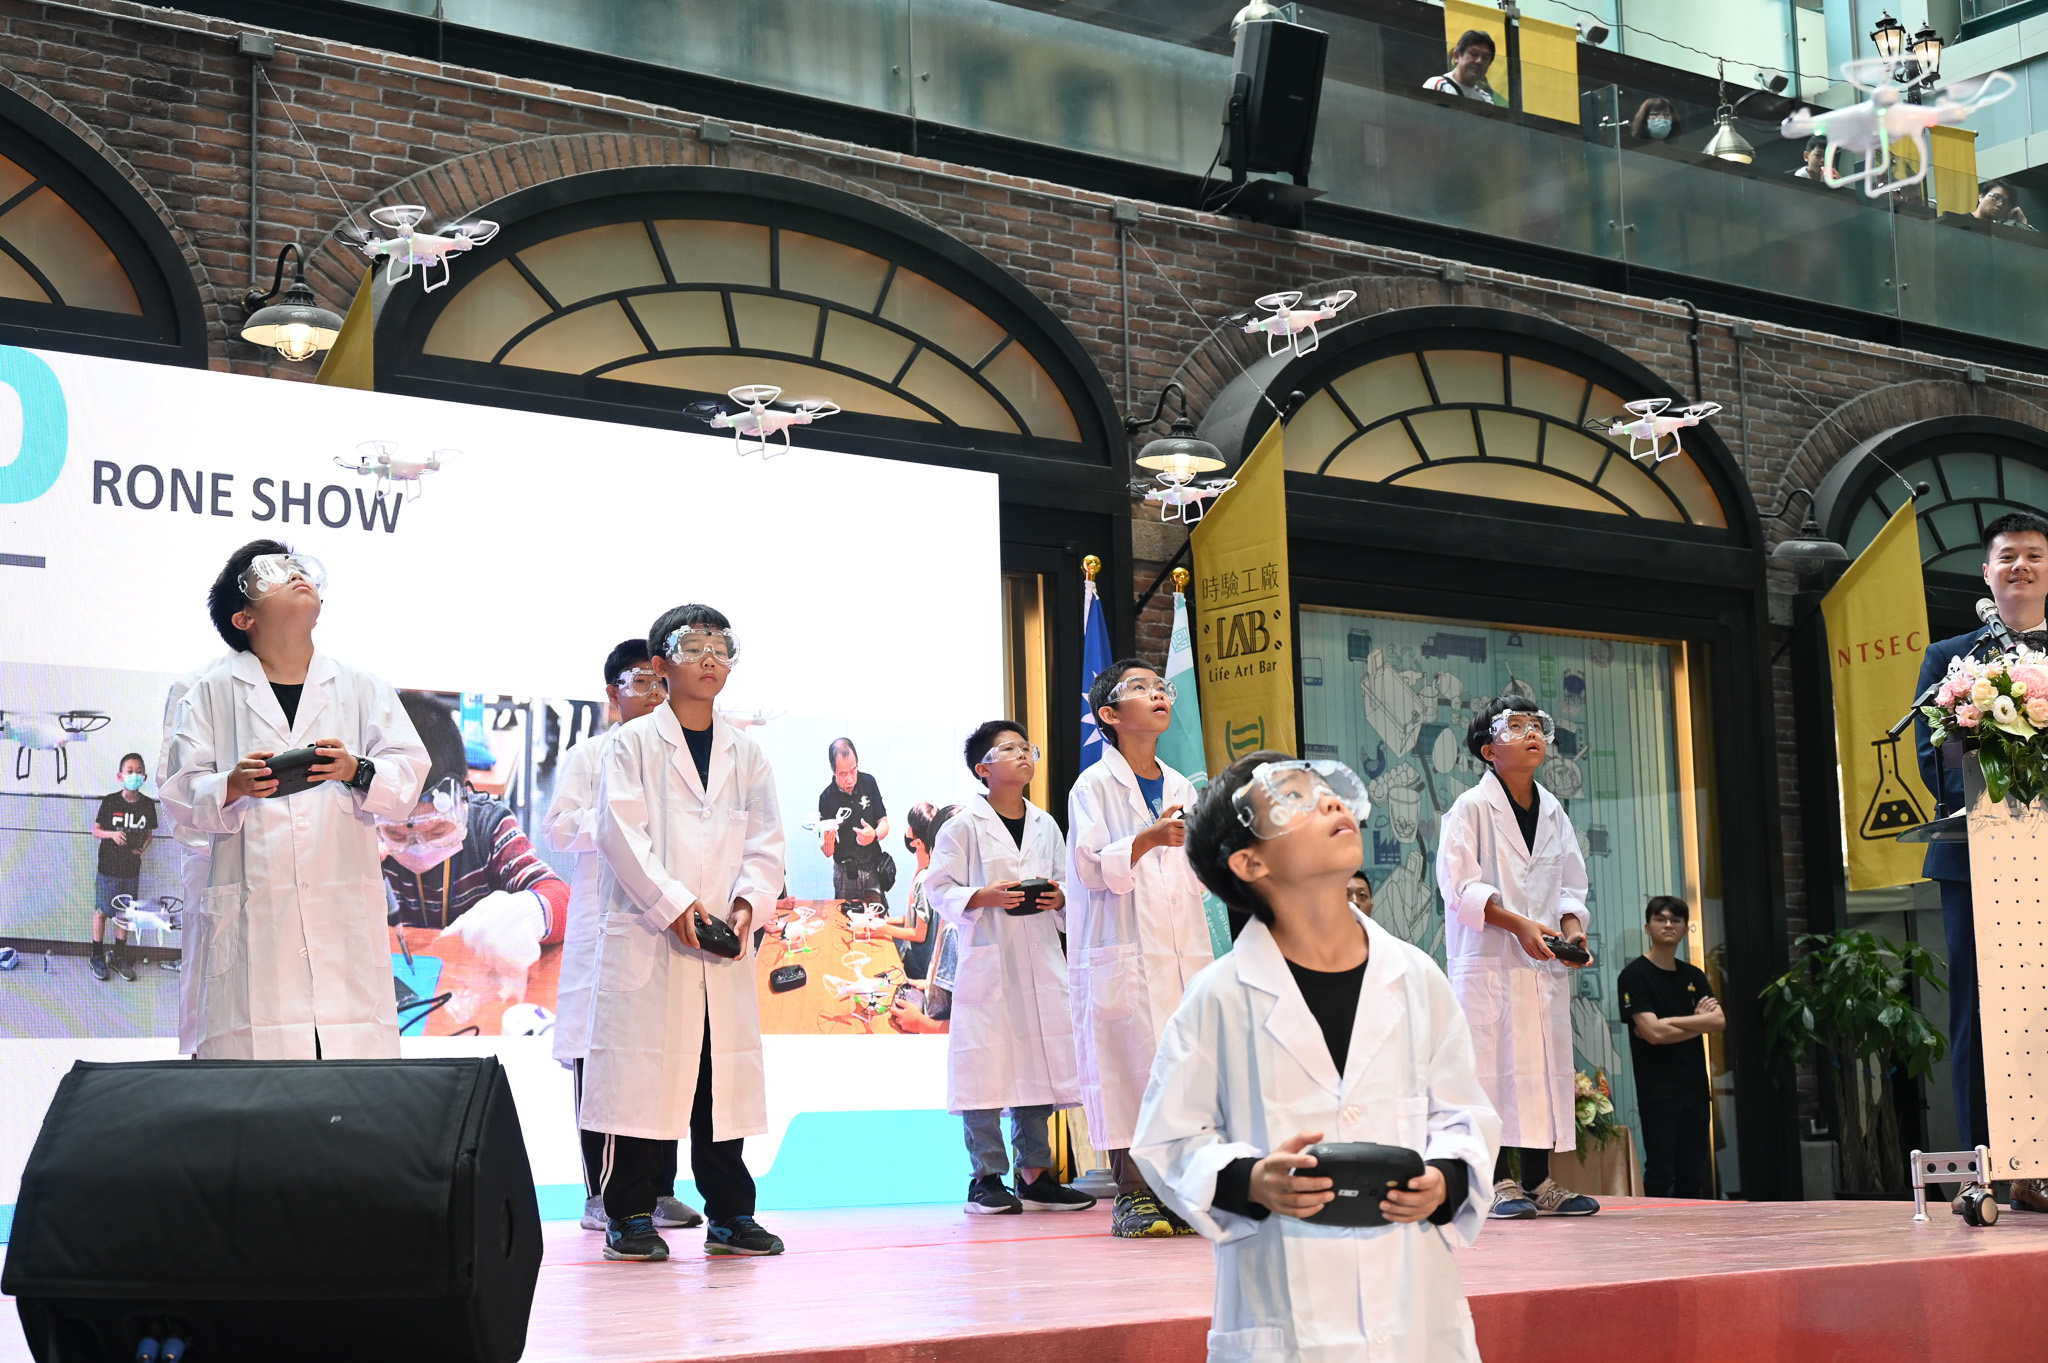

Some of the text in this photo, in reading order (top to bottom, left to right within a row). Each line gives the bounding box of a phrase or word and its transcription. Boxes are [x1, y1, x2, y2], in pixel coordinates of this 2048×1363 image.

[93, 459, 403, 534] RONE SHOW
[1202, 562, 1279, 602] 時驗工廠
[1216, 609, 1271, 660] LAB
[1838, 631, 1922, 668] NTSEC
[1209, 660, 1277, 683] Life Art Bar
[112, 812, 147, 829] FILA
